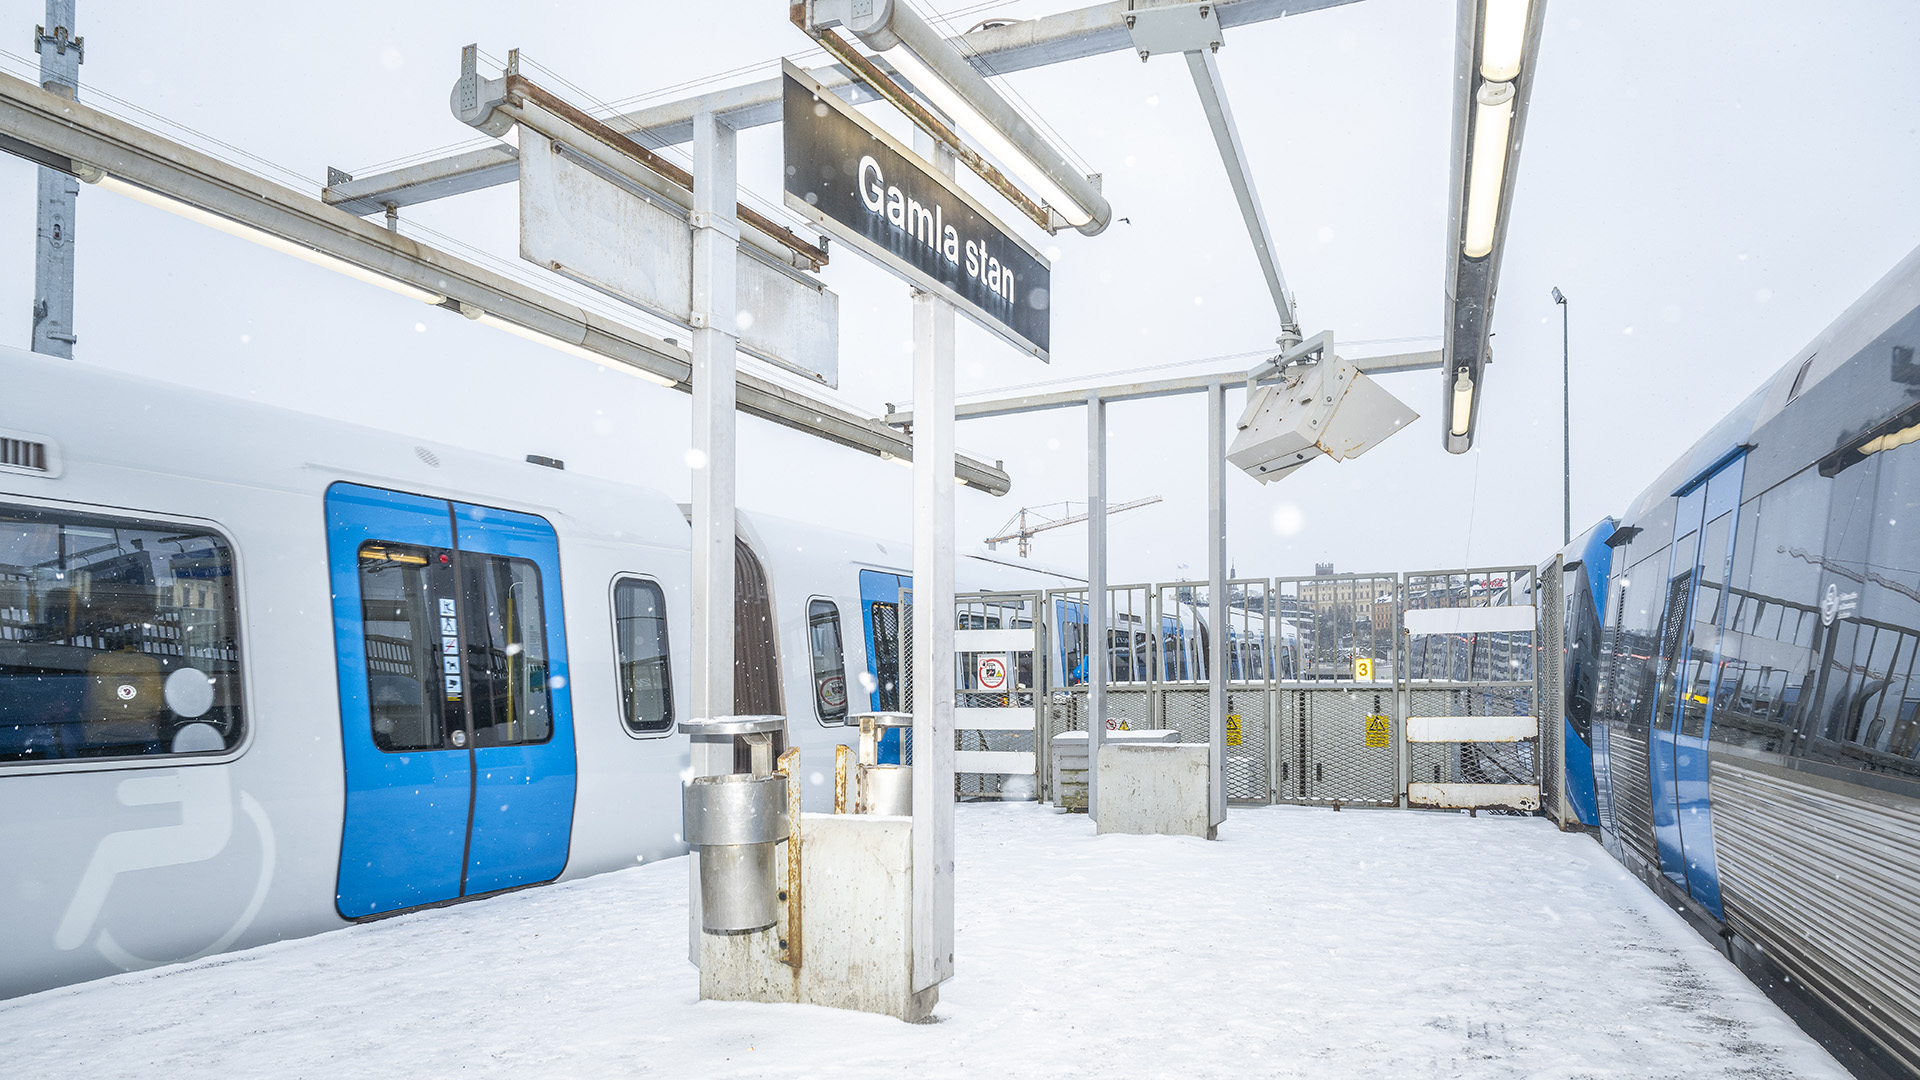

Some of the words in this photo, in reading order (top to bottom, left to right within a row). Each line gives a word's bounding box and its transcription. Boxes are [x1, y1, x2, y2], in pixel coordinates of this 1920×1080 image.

[858, 155, 959, 266] Gamla
[965, 239, 1016, 305] stan
[1481, 578, 1503, 589] Coa-Cola
[1358, 663, 1368, 677] 3
